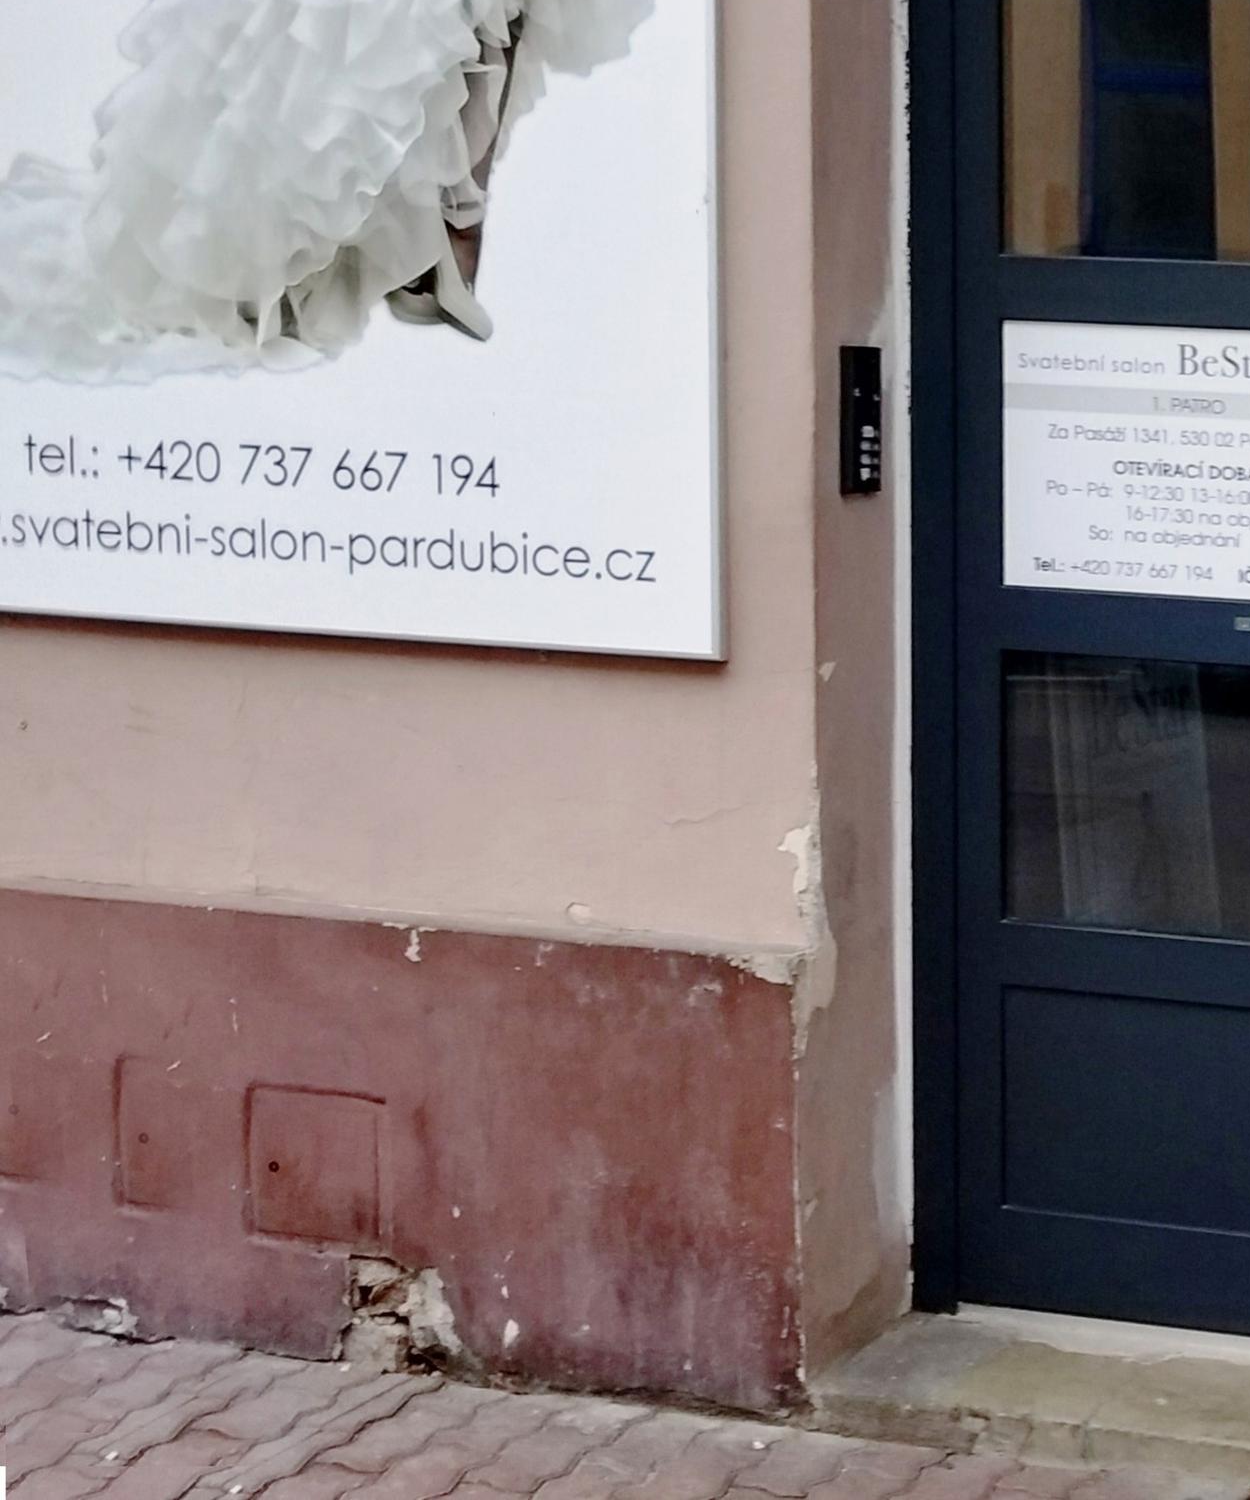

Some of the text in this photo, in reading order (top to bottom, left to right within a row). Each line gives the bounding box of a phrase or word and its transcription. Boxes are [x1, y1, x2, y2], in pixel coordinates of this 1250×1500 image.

[1018, 353, 1105, 372] Svatební
[1111, 357, 1166, 374] salon
[1171, 398, 1226, 415] PATRO
[1048, 423, 1069, 440] Za
[1180, 430, 1210, 446] 530
[1214, 431, 1234, 447] 02
[24, 434, 500, 498] tel.: +420 737 667 194
[1113, 459, 1205, 480] OTEVÍRACÍ
[1046, 479, 1068, 496] Po
[1199, 512, 1222, 526] na
[1088, 524, 1240, 548] So: na objednání
[1070, 559, 1110, 576] +420
[1115, 561, 1144, 578] 737
[1149, 564, 1178, 581] 667
[1186, 565, 1213, 582] 194
